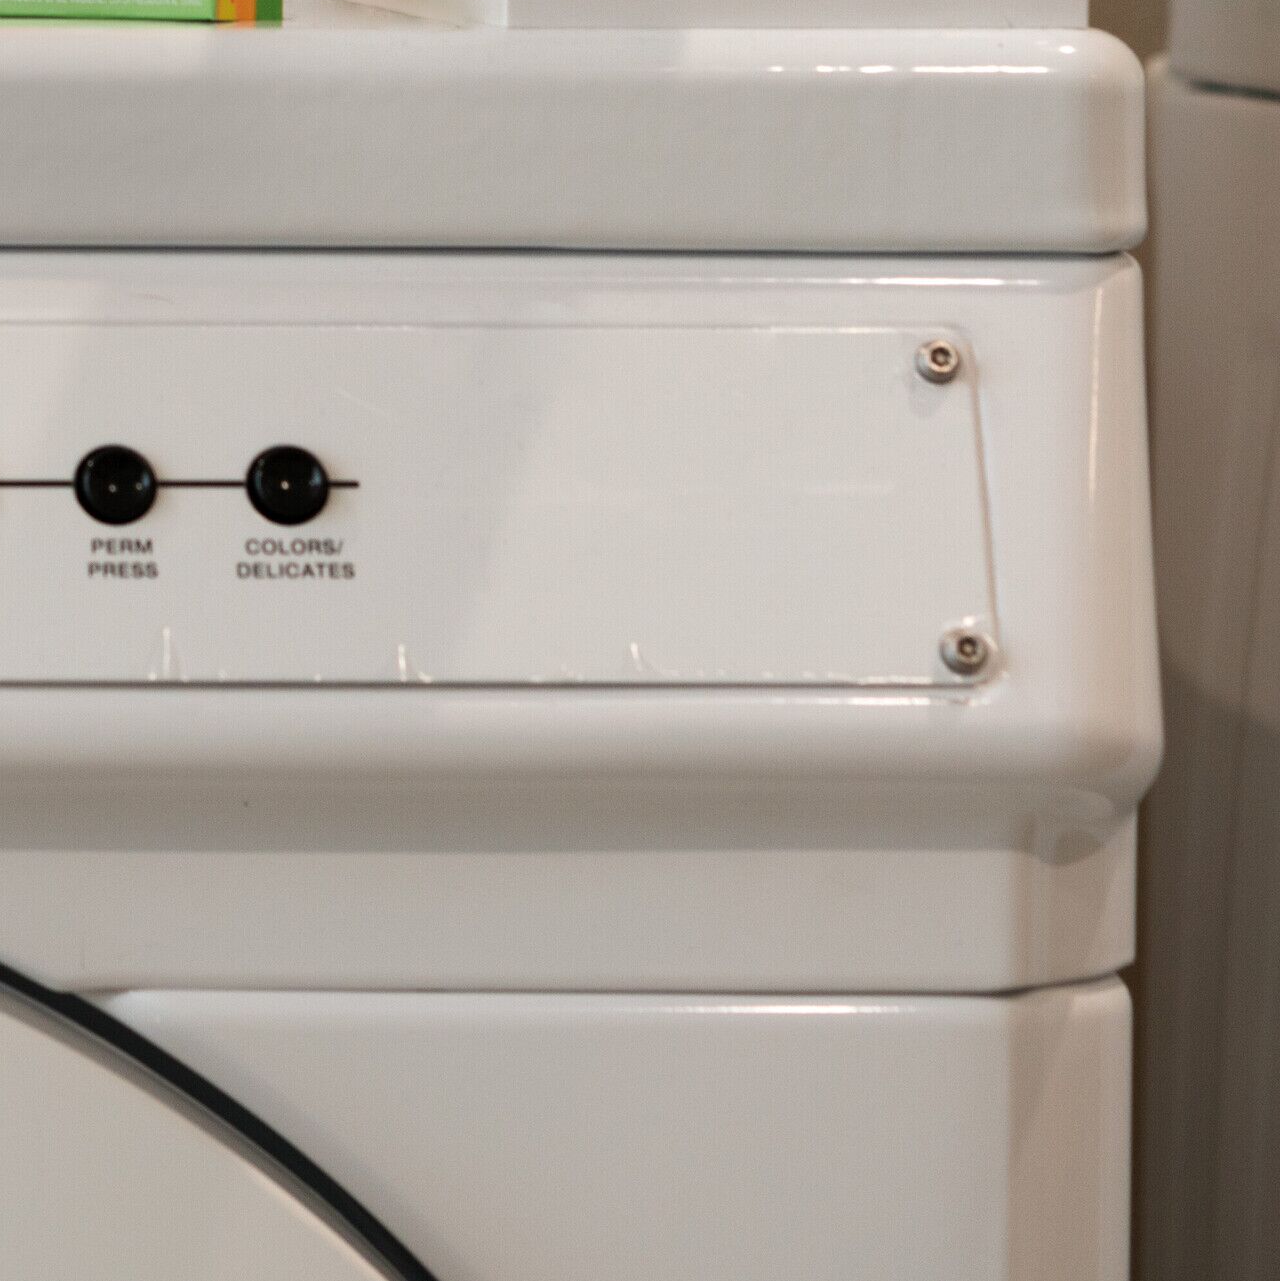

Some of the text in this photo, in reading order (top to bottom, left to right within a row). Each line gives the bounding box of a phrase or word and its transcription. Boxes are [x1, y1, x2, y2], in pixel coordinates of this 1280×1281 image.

[91, 538, 153, 556] PERM
[245, 537, 343, 556] COLORS/
[88, 561, 158, 580] PRESS
[237, 561, 355, 580] DELICATES
